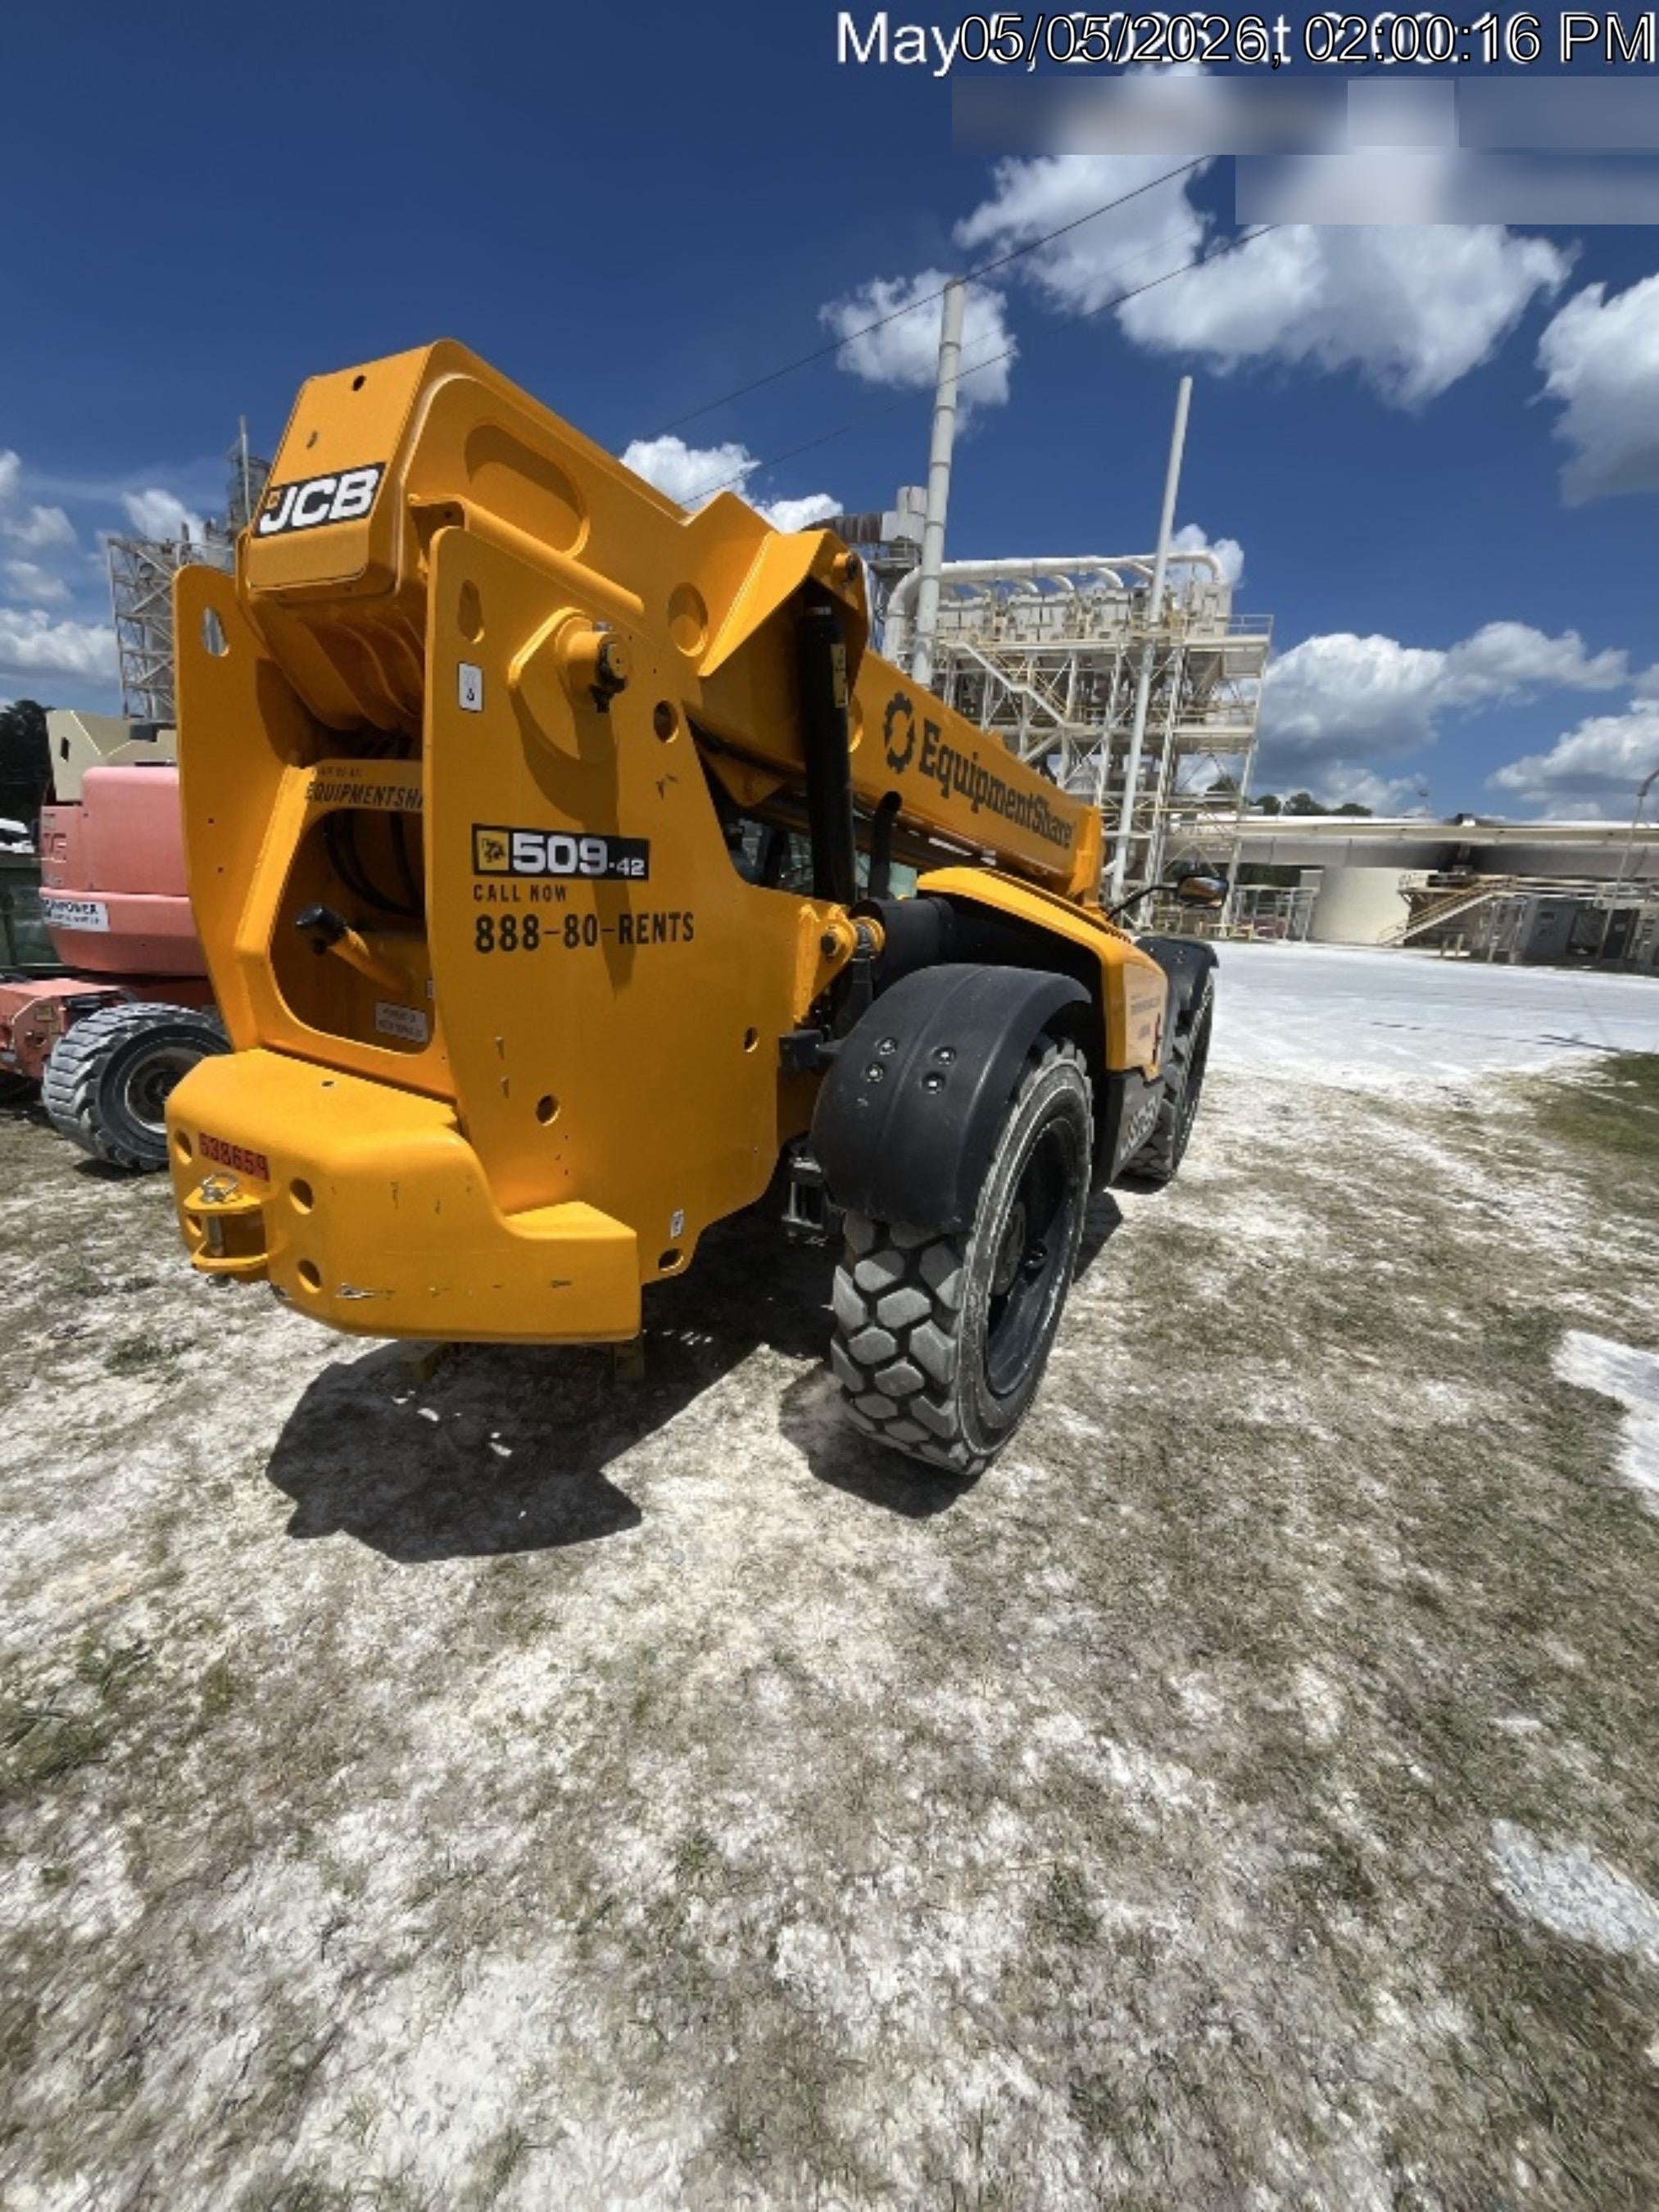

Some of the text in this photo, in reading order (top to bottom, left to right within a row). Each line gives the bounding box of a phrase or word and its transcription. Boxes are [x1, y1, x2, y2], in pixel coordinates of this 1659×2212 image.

[260, 469, 379, 534] JCB
[919, 718, 1072, 850] EquipmentShare
[474, 884, 568, 902] CALL NOW
[475, 912, 694, 954] 888-80-RENTS
[199, 1132, 270, 1182] 538659
